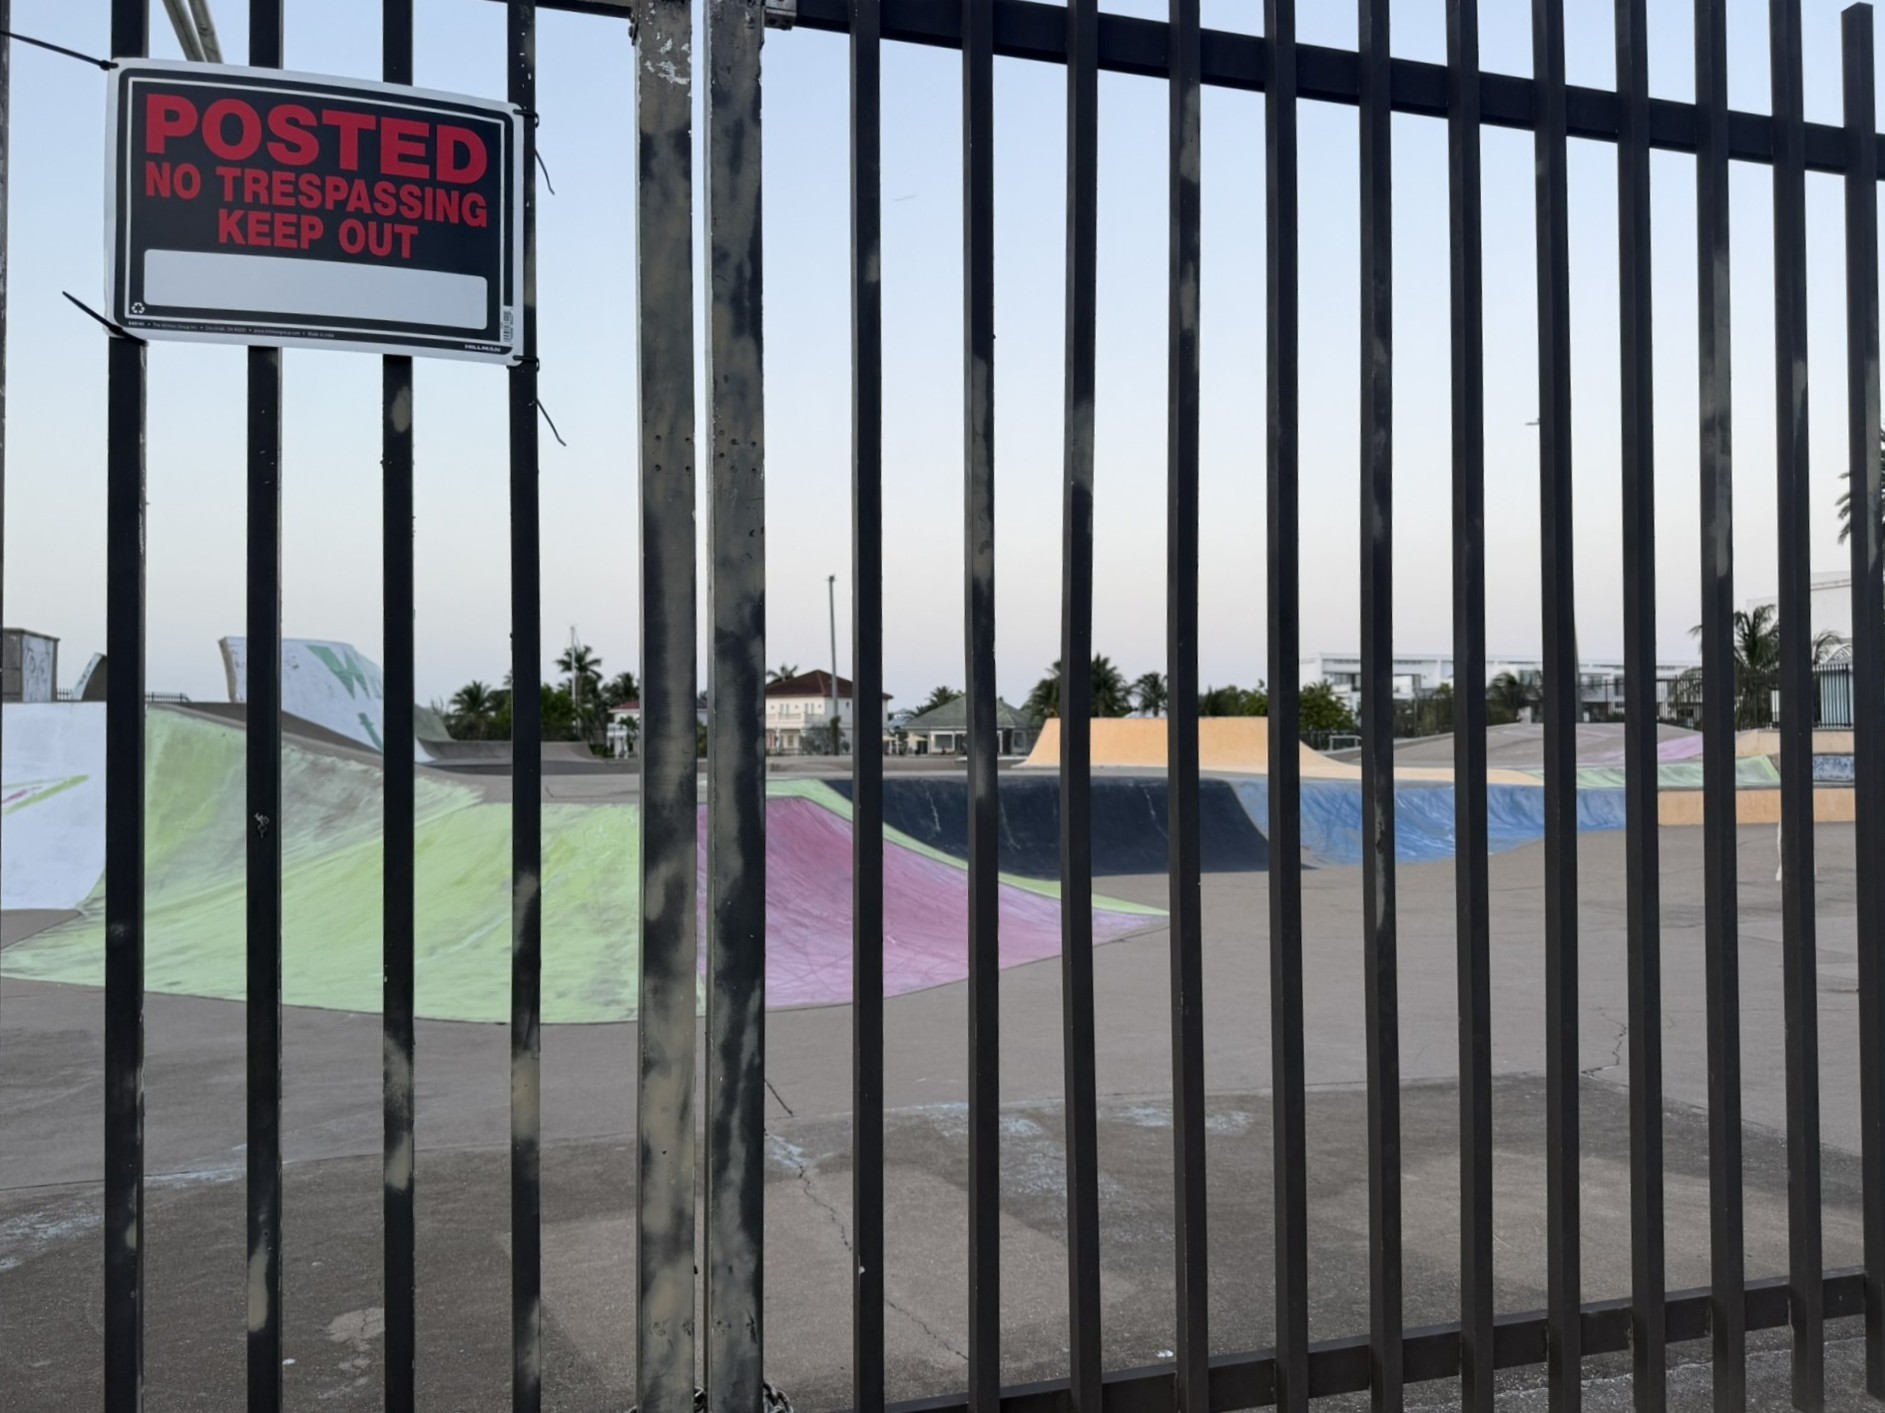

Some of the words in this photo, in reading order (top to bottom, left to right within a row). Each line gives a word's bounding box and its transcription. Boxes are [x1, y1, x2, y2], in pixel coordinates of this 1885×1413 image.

[147, 94, 488, 185] POSTED
[146, 162, 201, 200] NO
[216, 166, 488, 227] TRESPASSING
[219, 209, 324, 250] KEEP
[339, 219, 418, 258] OUT
